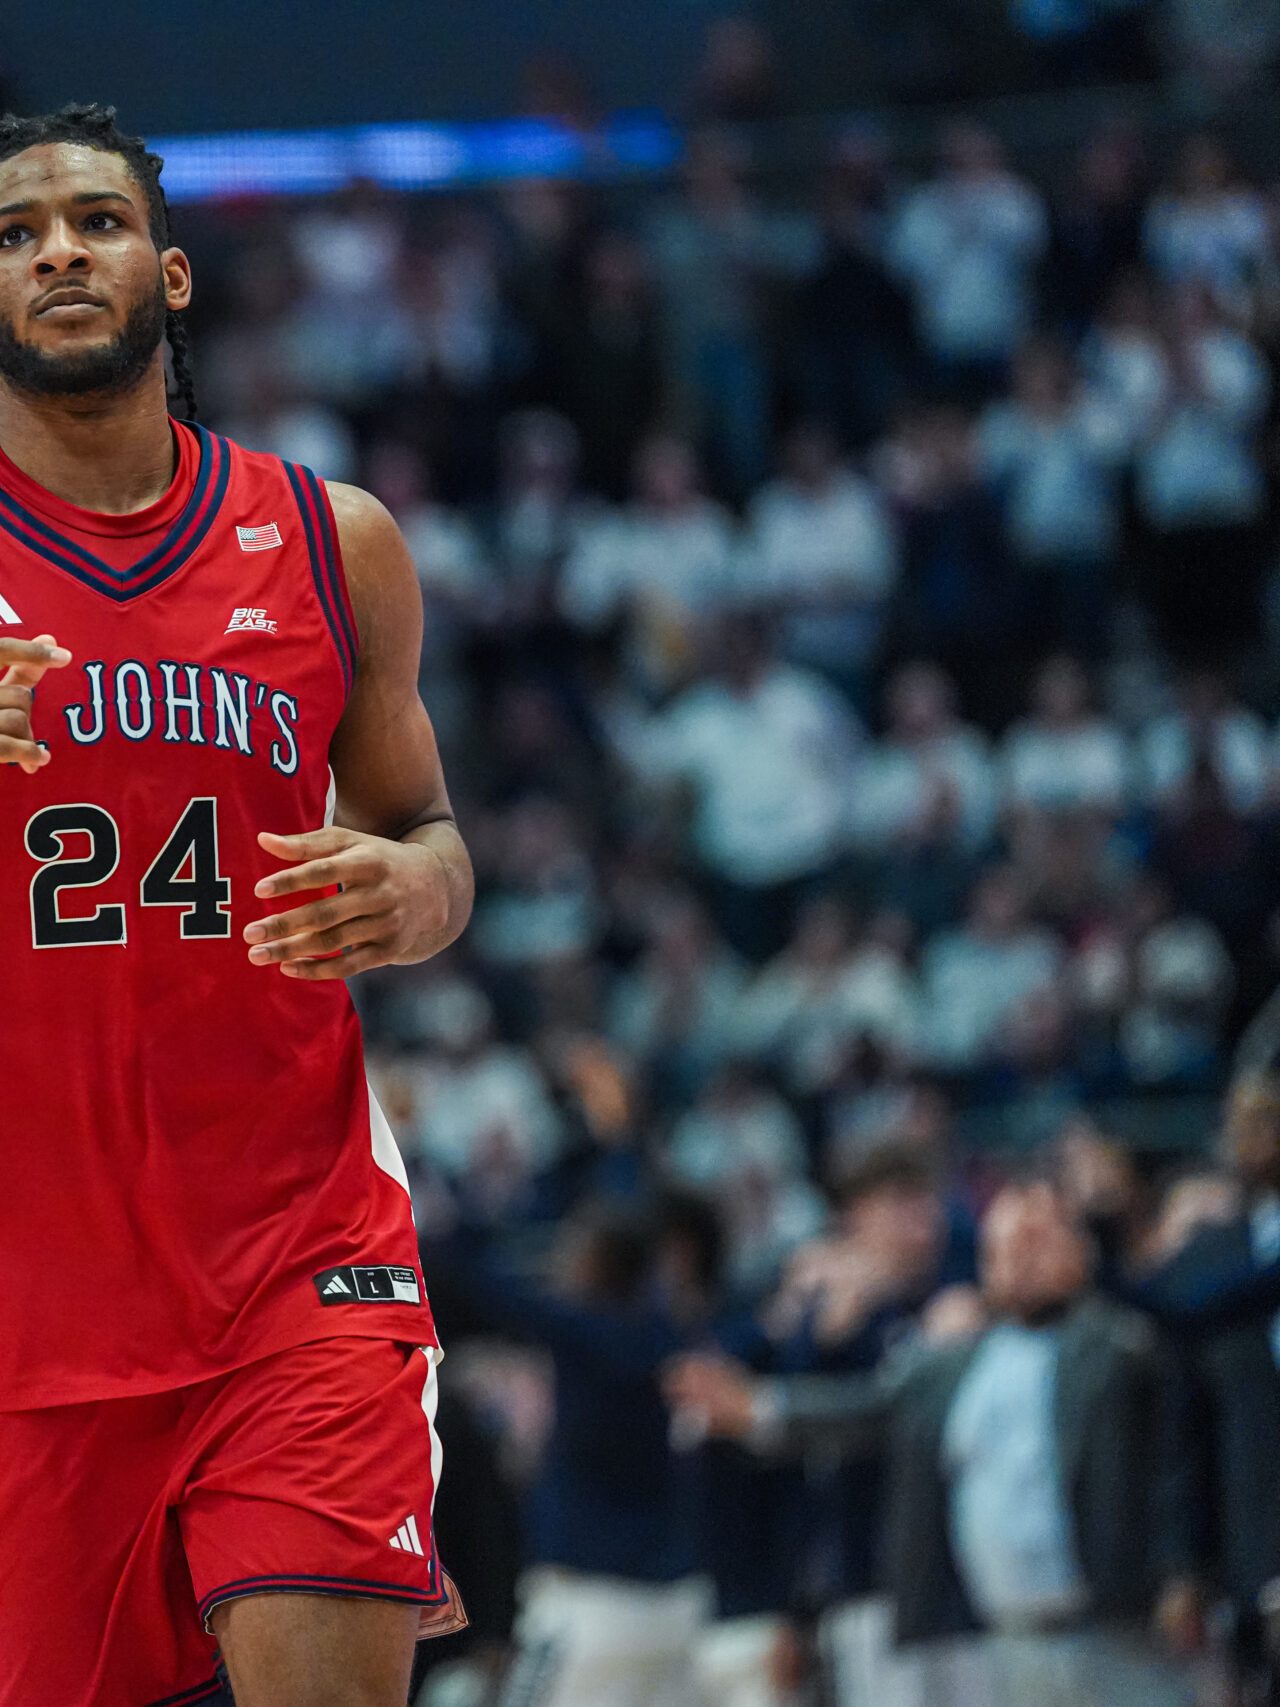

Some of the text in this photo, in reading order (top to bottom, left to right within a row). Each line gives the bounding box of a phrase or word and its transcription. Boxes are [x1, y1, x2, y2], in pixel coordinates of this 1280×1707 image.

[231, 607, 268, 619] BIG
[227, 617, 278, 630] EAST
[63, 658, 300, 777] JOHN'S
[24, 796, 232, 949] 24
[369, 1280, 380, 1294] L
